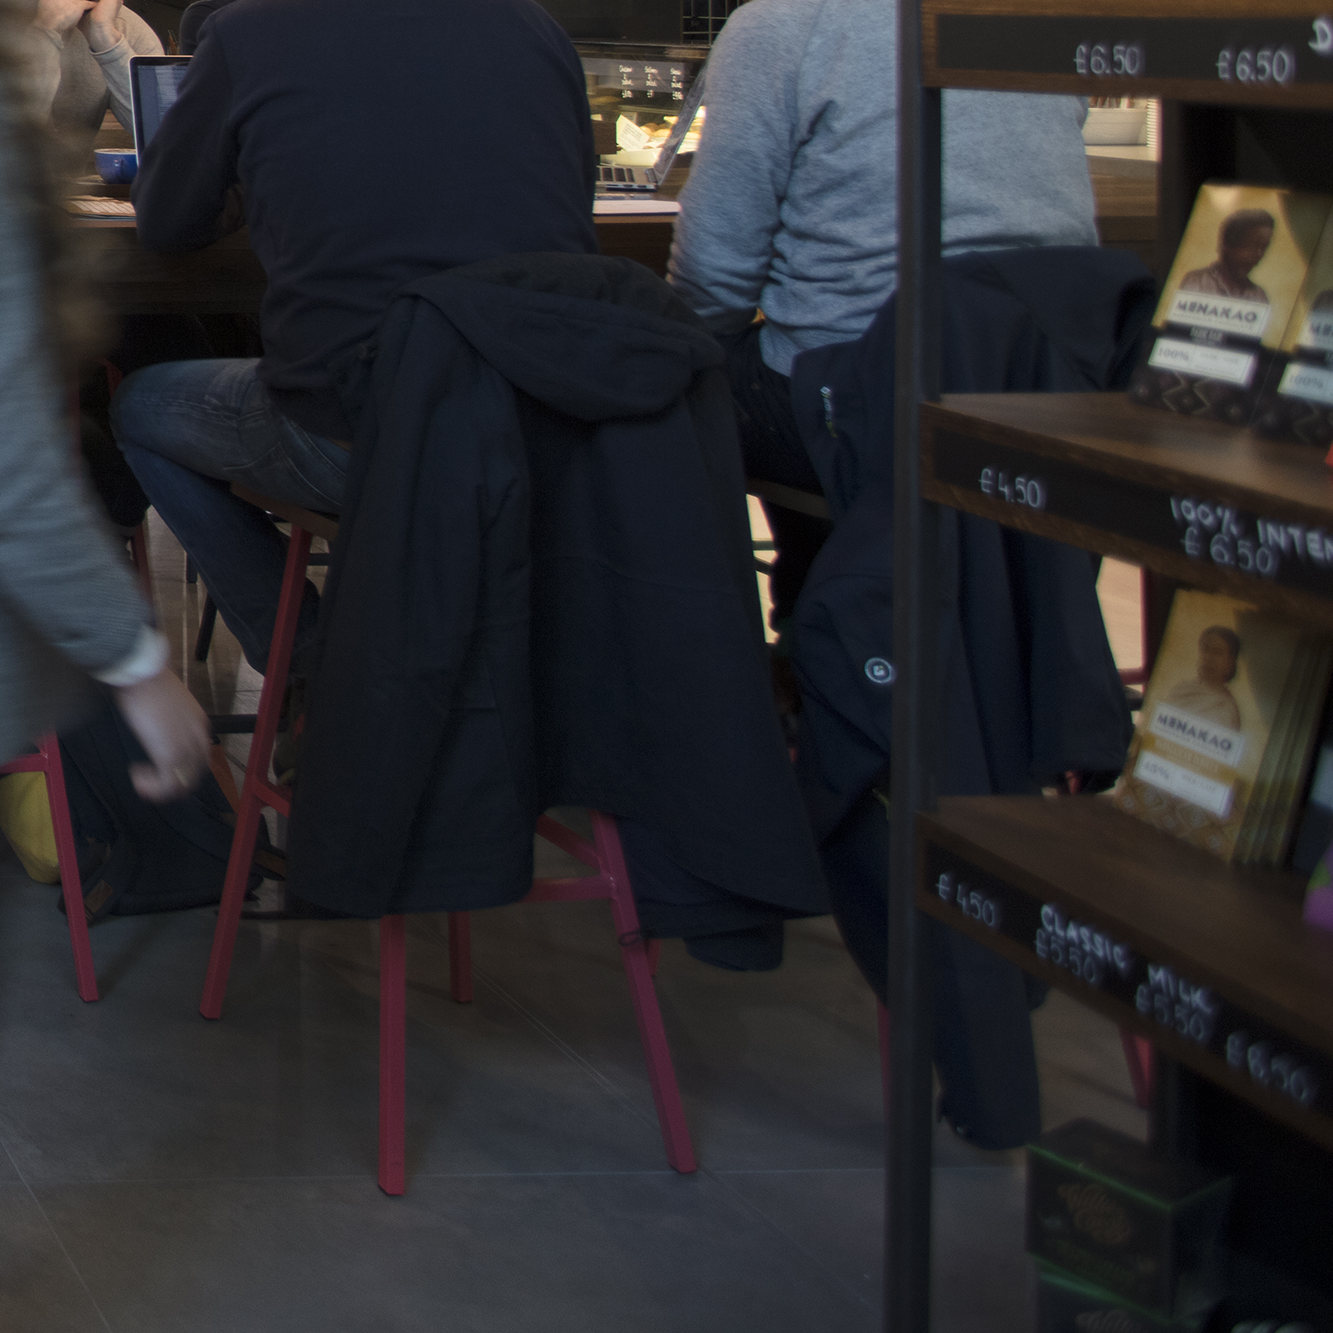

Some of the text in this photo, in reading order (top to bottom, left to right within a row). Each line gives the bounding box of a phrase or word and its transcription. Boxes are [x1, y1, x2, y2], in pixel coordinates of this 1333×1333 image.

[1073, 44, 1141, 76] £6.50
[1215, 49, 1291, 83] £6.50
[978, 467, 1042, 509] £4.50
[935, 873, 995, 926] £4.50
[1040, 903, 1130, 972] CLASSIC
[1147, 962, 1215, 1015] MILK
